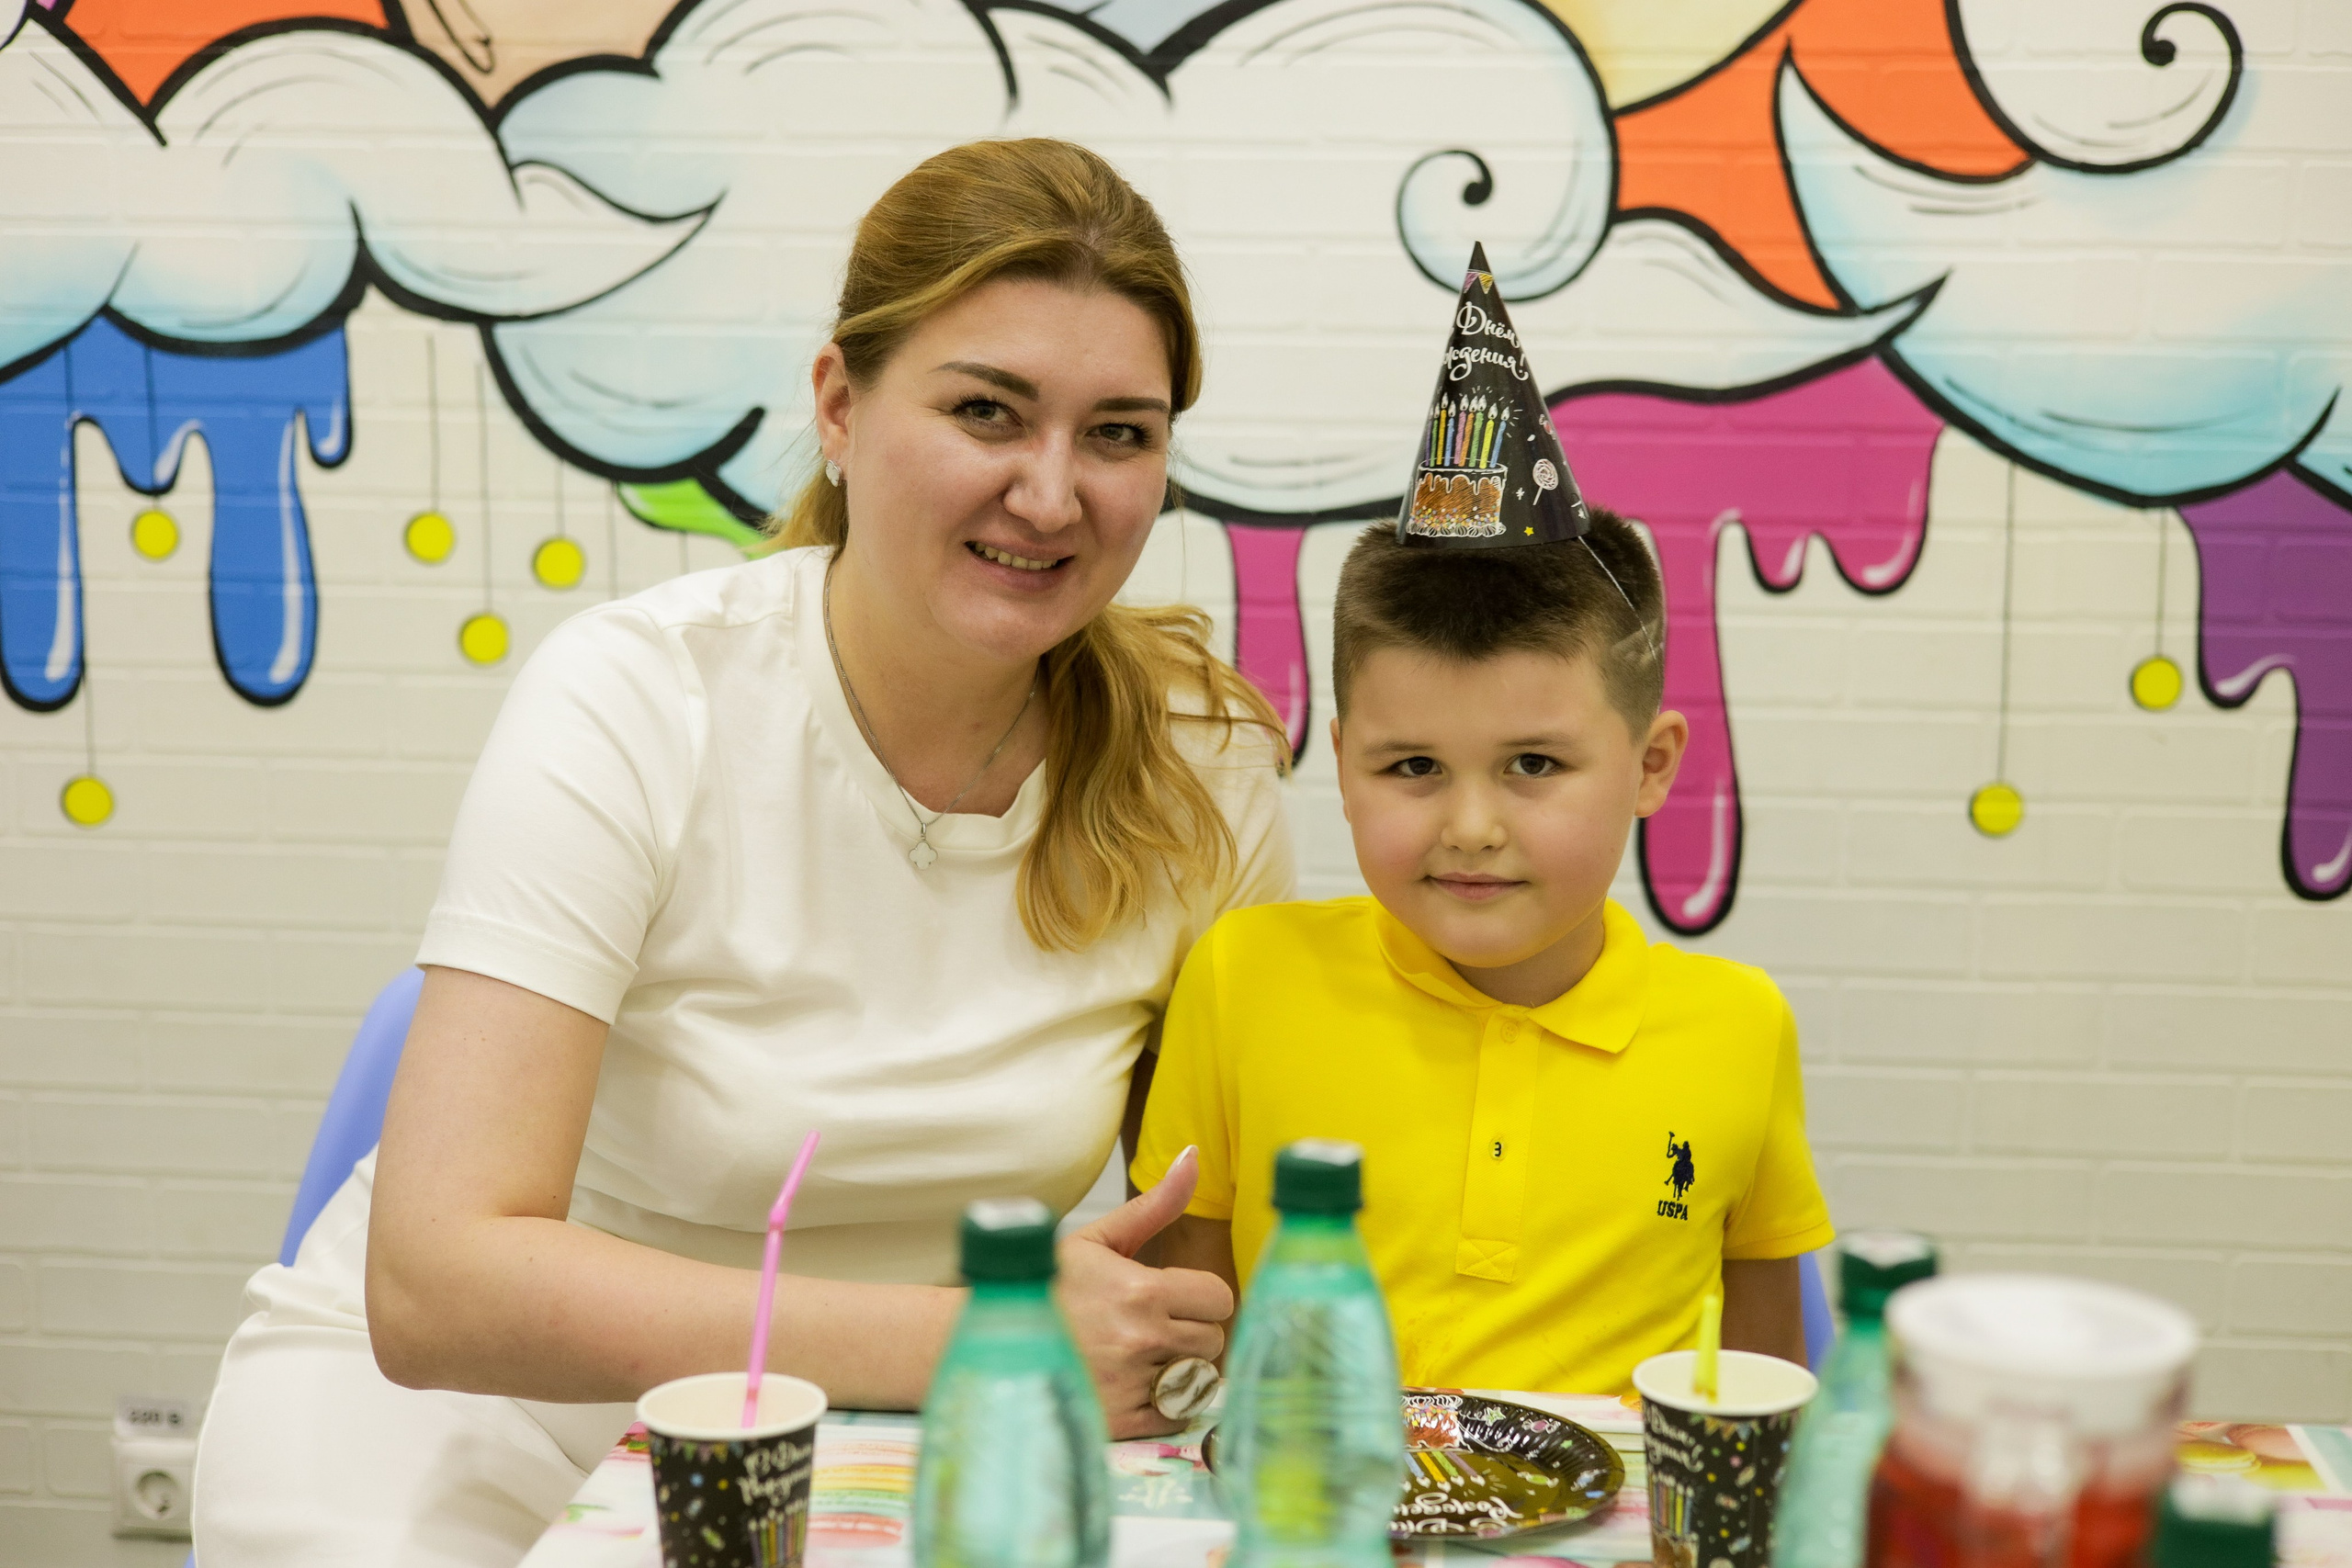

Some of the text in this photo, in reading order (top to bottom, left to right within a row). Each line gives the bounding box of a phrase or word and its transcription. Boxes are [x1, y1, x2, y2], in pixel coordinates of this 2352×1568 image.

[1456, 301, 1521, 348] Днём
[1443, 346, 1530, 381] ждения!
[1657, 1199, 1689, 1222] USPA
